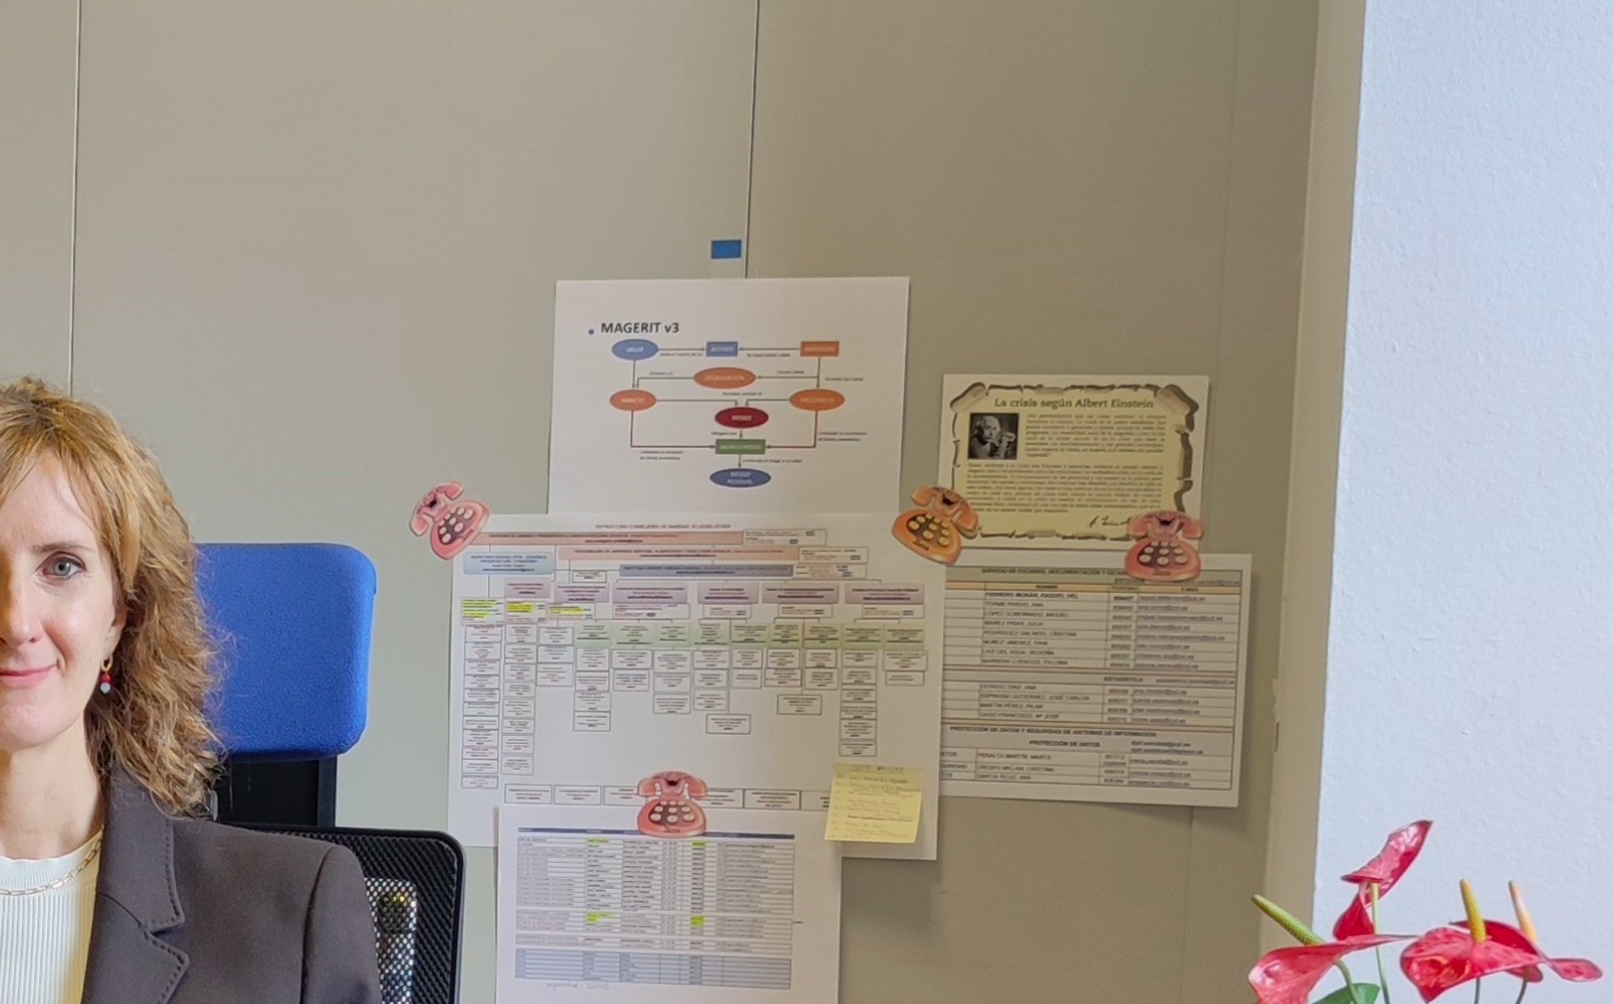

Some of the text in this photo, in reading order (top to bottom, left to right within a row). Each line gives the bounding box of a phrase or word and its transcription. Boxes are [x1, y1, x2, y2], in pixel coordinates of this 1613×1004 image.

[600, 322, 680, 334] MAGERIT v3
[994, 398, 1154, 410] La crisis según Albert Einstein
